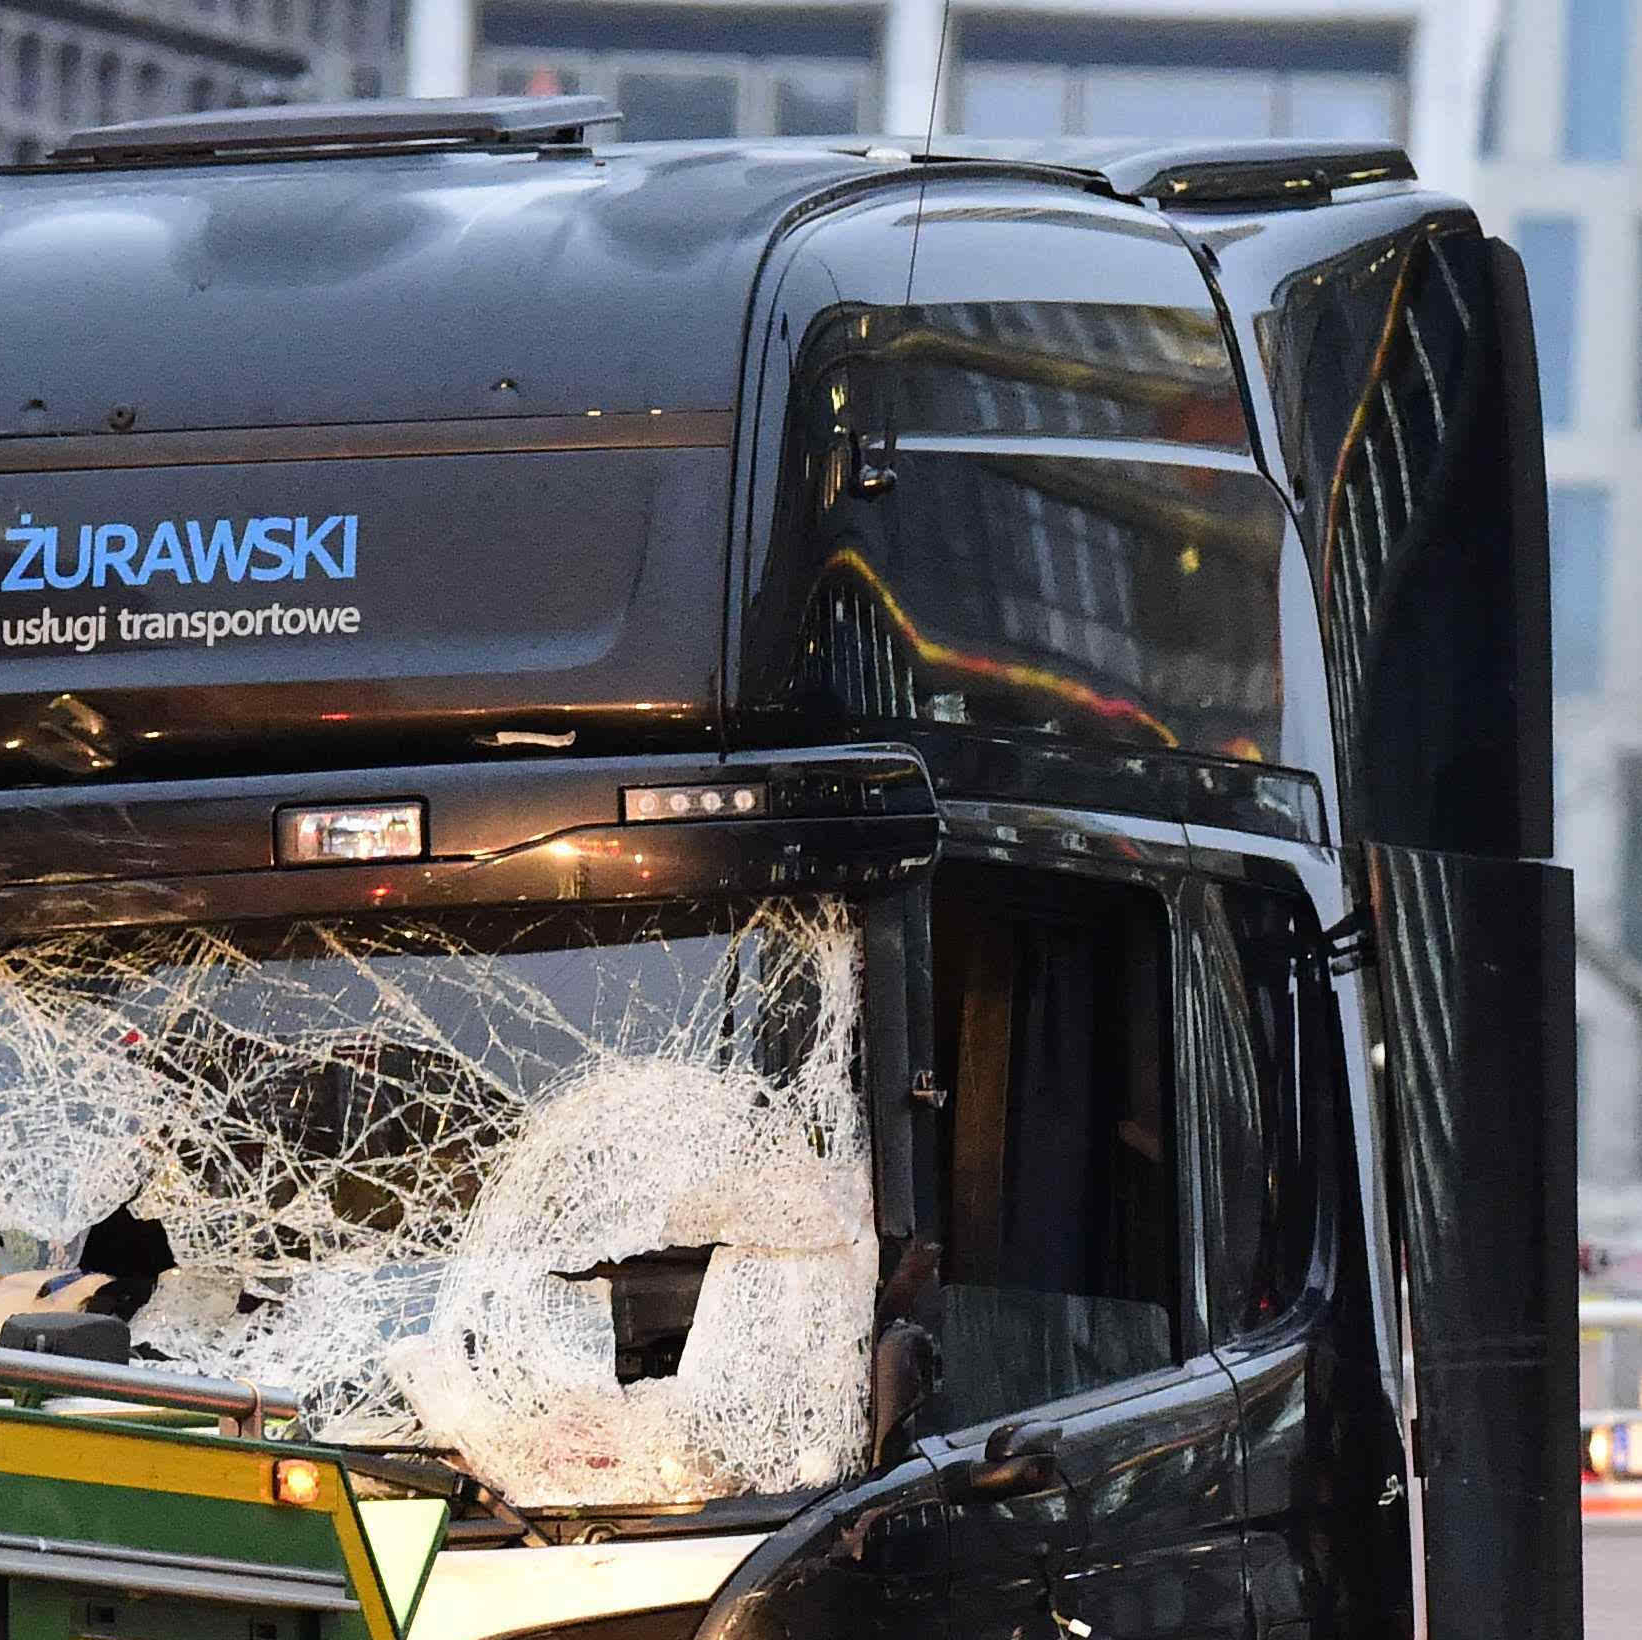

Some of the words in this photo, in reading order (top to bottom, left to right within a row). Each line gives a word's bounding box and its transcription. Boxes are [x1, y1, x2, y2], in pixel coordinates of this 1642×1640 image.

[2, 512, 358, 592] ŻURAWSKI
[2, 605, 107, 651] usługi
[118, 603, 362, 646] transportowe
